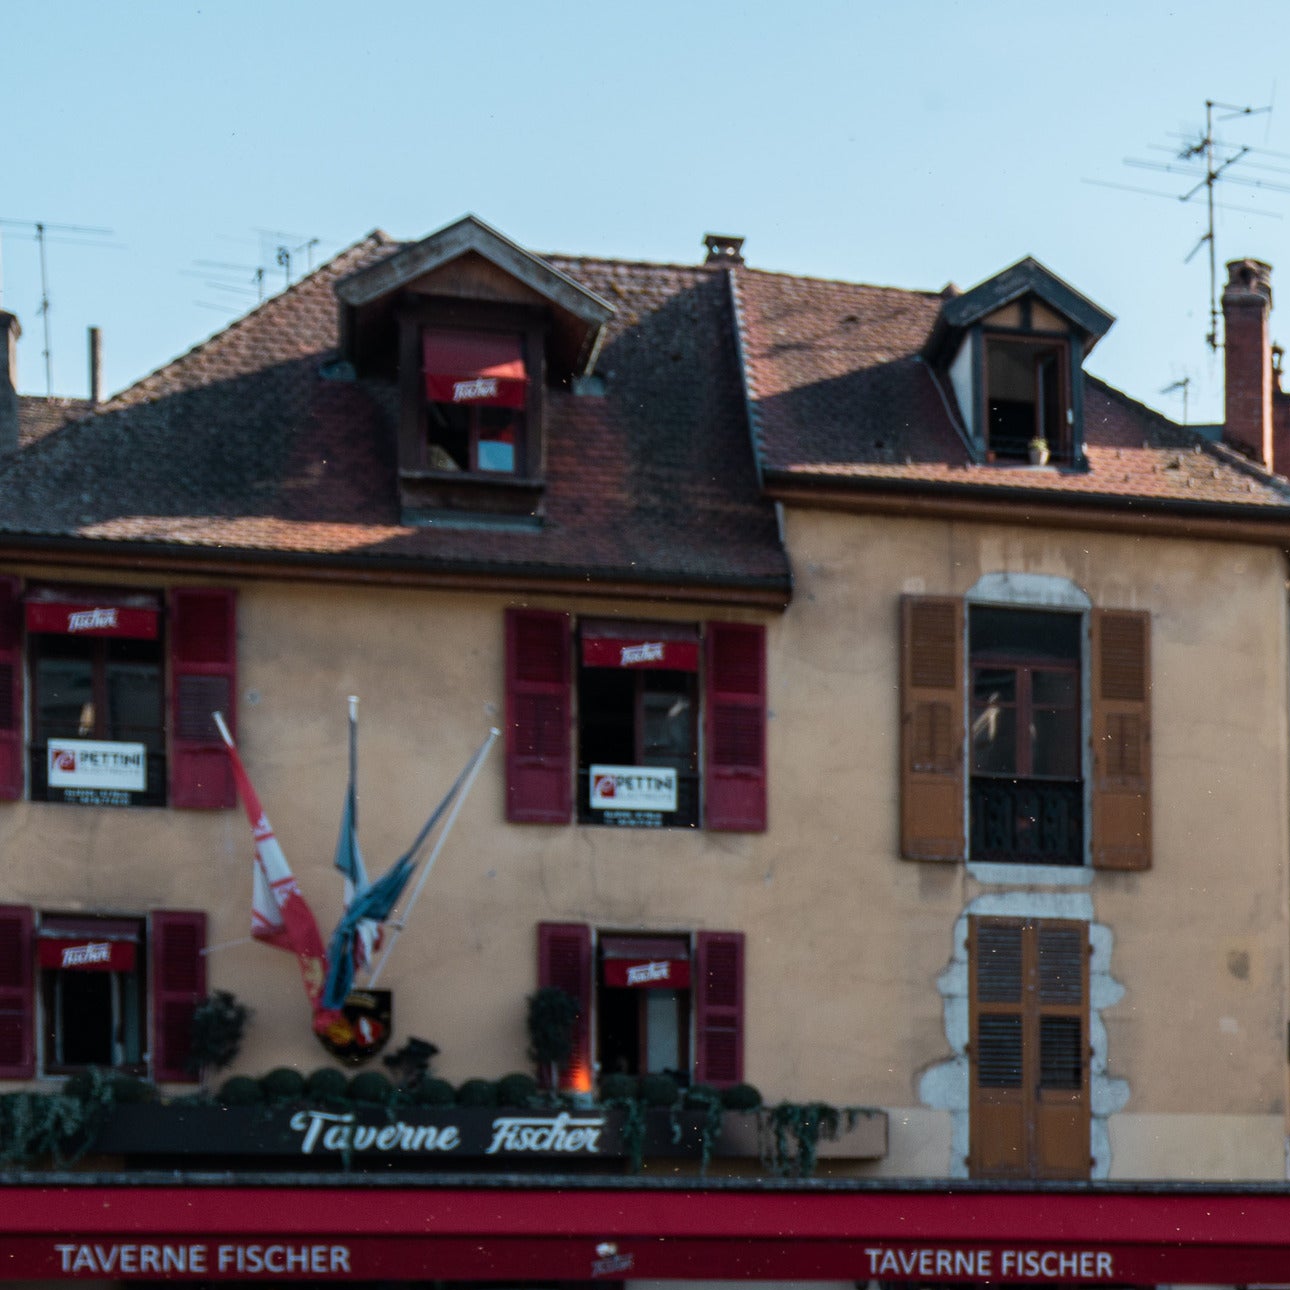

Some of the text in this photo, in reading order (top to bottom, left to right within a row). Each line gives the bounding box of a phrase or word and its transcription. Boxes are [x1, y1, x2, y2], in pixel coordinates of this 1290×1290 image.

[290, 1110, 605, 1154] Taverne Fischer
[54, 1244, 351, 1274] TAVERNE FISCHER
[864, 1248, 1114, 1279] TAVERNE FISCHER
